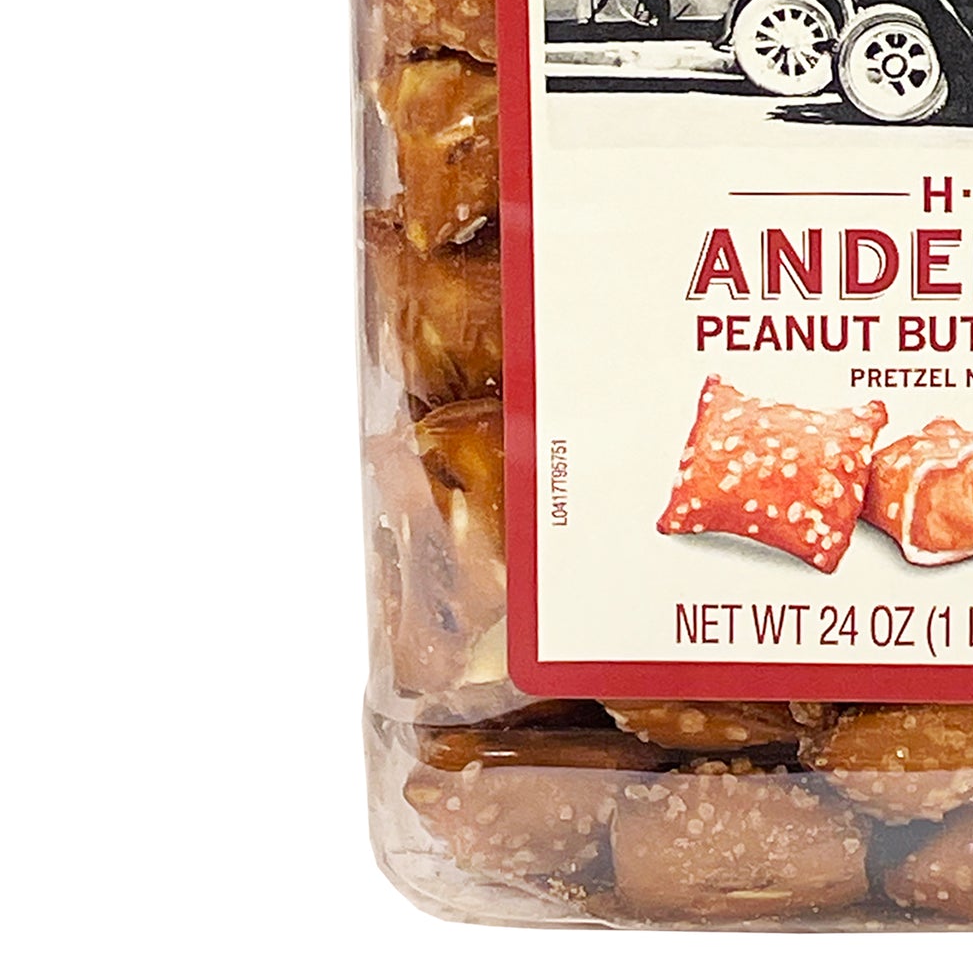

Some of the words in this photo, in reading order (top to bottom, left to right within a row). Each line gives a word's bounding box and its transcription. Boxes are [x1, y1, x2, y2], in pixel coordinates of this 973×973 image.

[697, 315, 880, 352] PEANUT
[851, 368, 956, 387] PRETZEL
[676, 604, 742, 644] NET
[752, 604, 810, 645] WT
[820, 606, 858, 645] 24
[871, 605, 914, 647] OZ
[927, 606, 950, 657] (1
